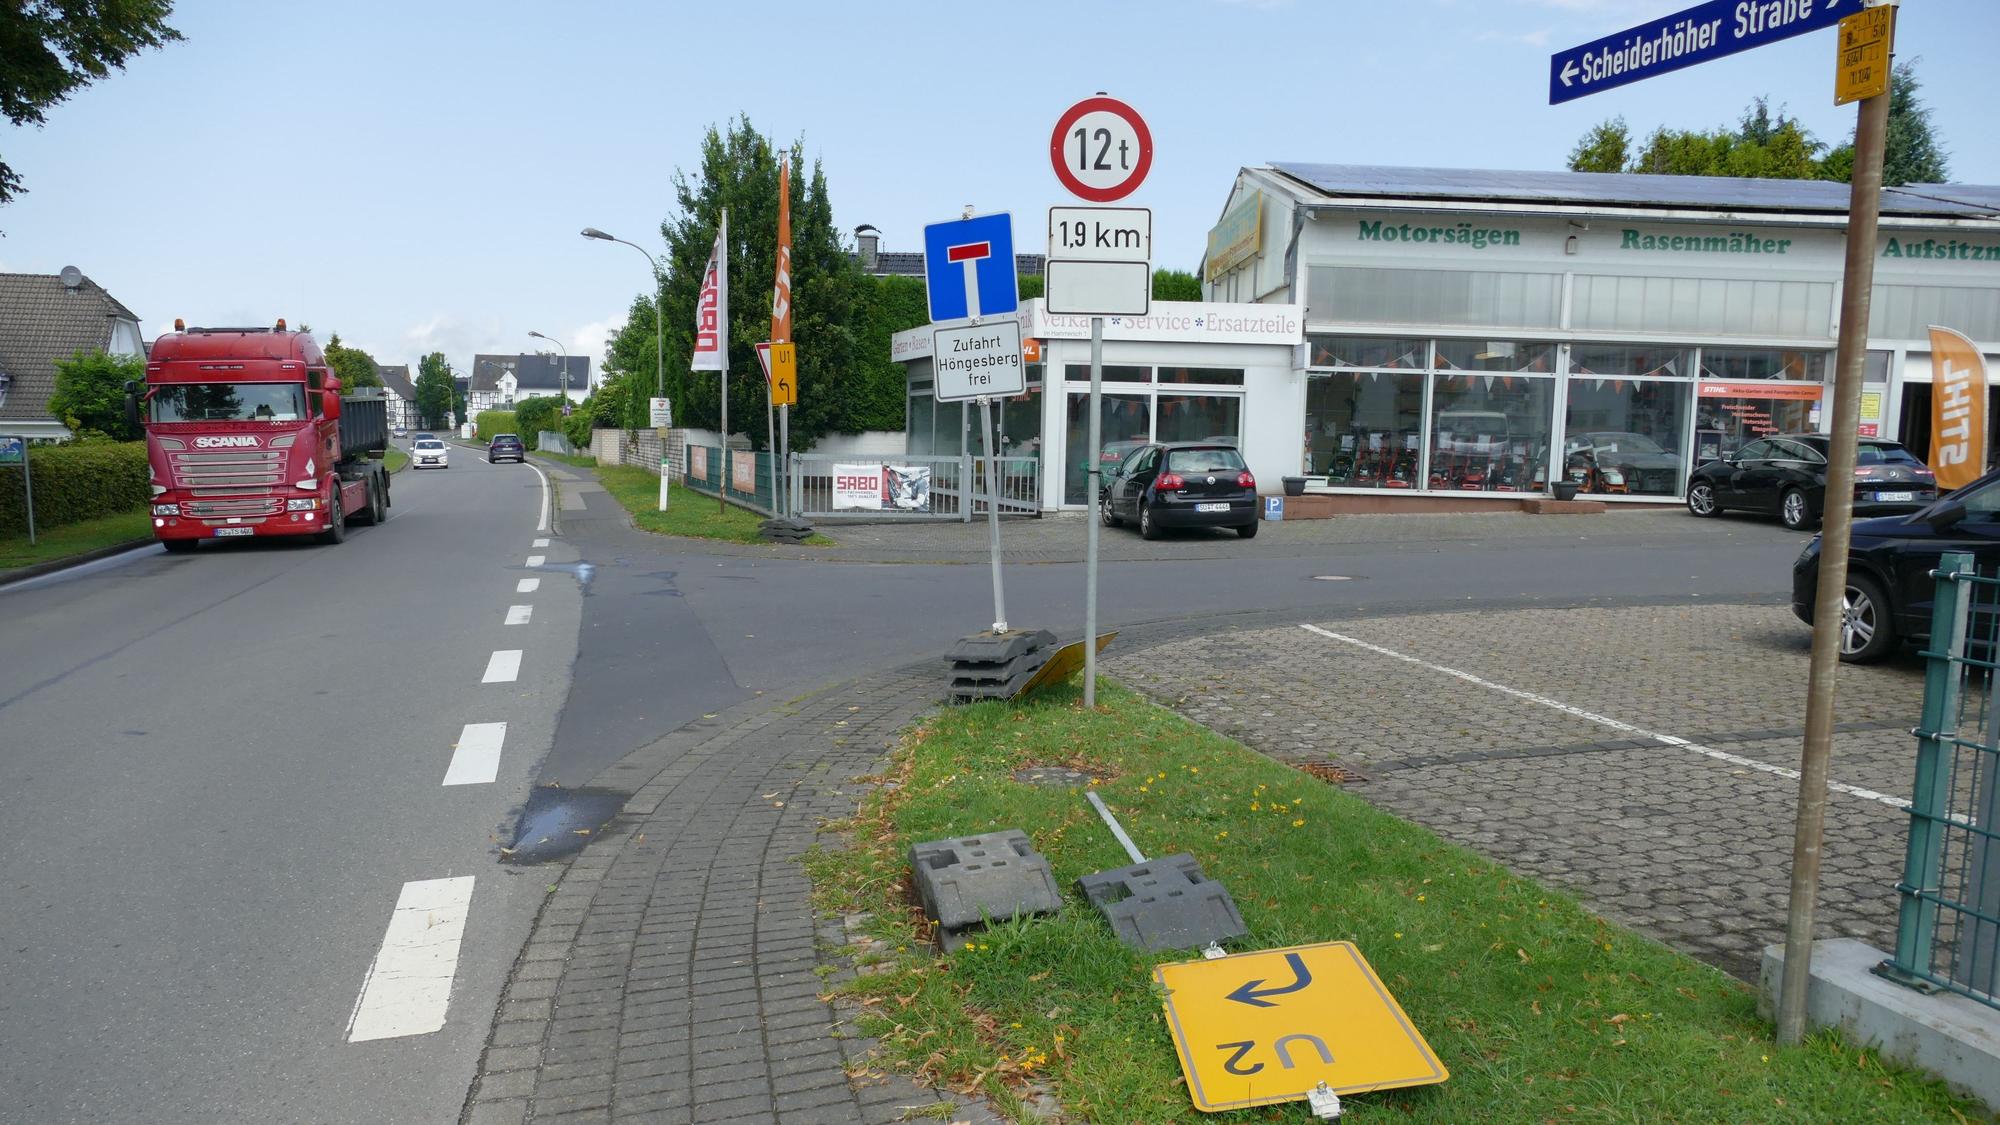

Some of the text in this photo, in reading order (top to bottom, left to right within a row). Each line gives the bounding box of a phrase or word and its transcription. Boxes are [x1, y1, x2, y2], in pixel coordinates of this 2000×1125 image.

[1581, 0, 1813, 84] Scheiderhöher Straße
[1060, 221, 1140, 248] 1,9 km
[1358, 220, 1520, 249] Motorsägen
[1620, 228, 1792, 254] Rasenmäher
[1124, 311, 1191, 331] Service
[1206, 312, 1296, 334] Ersatzteile
[953, 335, 1001, 353] Zufahrt
[779, 350, 790, 364] U1
[939, 353, 1018, 372] Höngesberg
[969, 371, 991, 386] frei
[196, 436, 259, 448] SCANIA
[837, 476, 878, 490] SABO
[1270, 498, 1280, 511] P
[1216, 1034, 1335, 1076] U2
